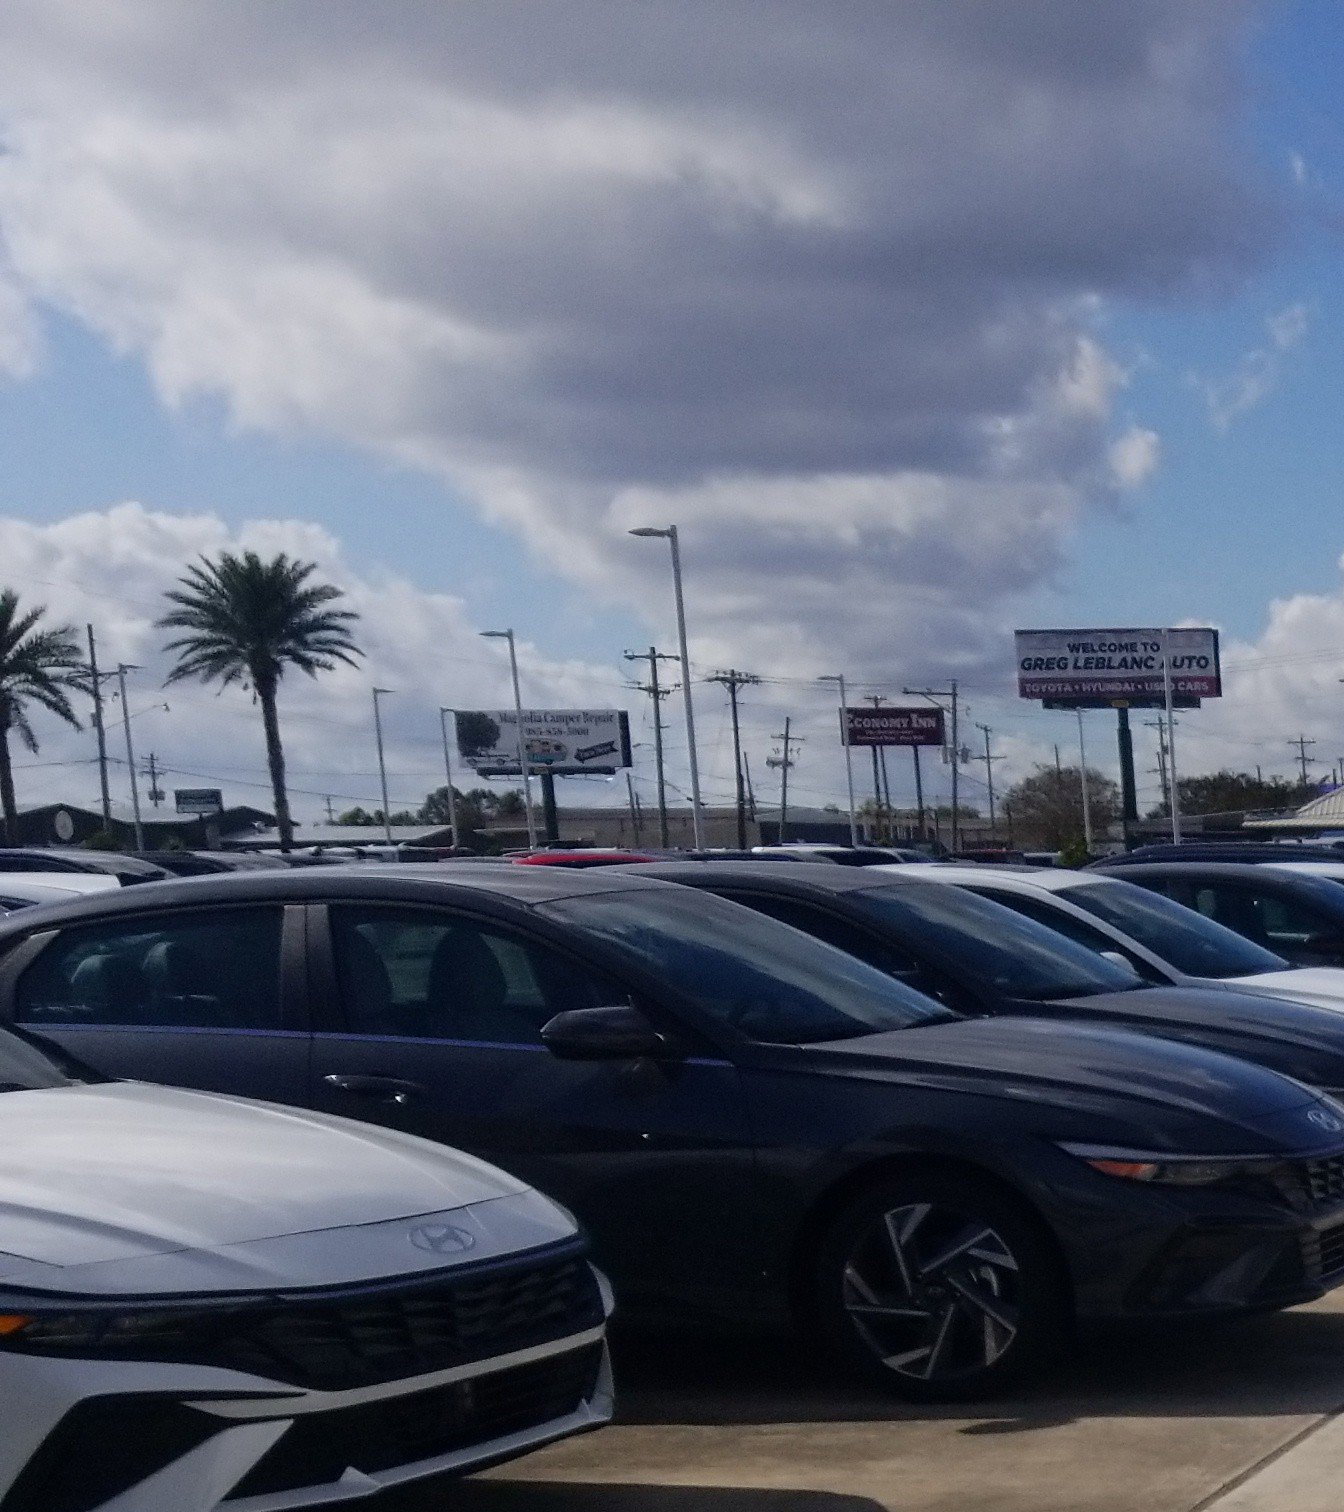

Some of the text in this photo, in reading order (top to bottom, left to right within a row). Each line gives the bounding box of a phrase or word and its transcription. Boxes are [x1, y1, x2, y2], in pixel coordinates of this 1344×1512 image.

[1067, 642, 1161, 654] WELCOME TO
[1020, 656, 1068, 671] GREG
[1073, 655, 1155, 671] LEBLANC
[1025, 682, 1072, 693] TOYOTA
[1082, 681, 1136, 693] HYUNDAI
[1178, 681, 1209, 691] CARS
[499, 711, 542, 724] Magolia
[543, 712, 580, 725] Camper
